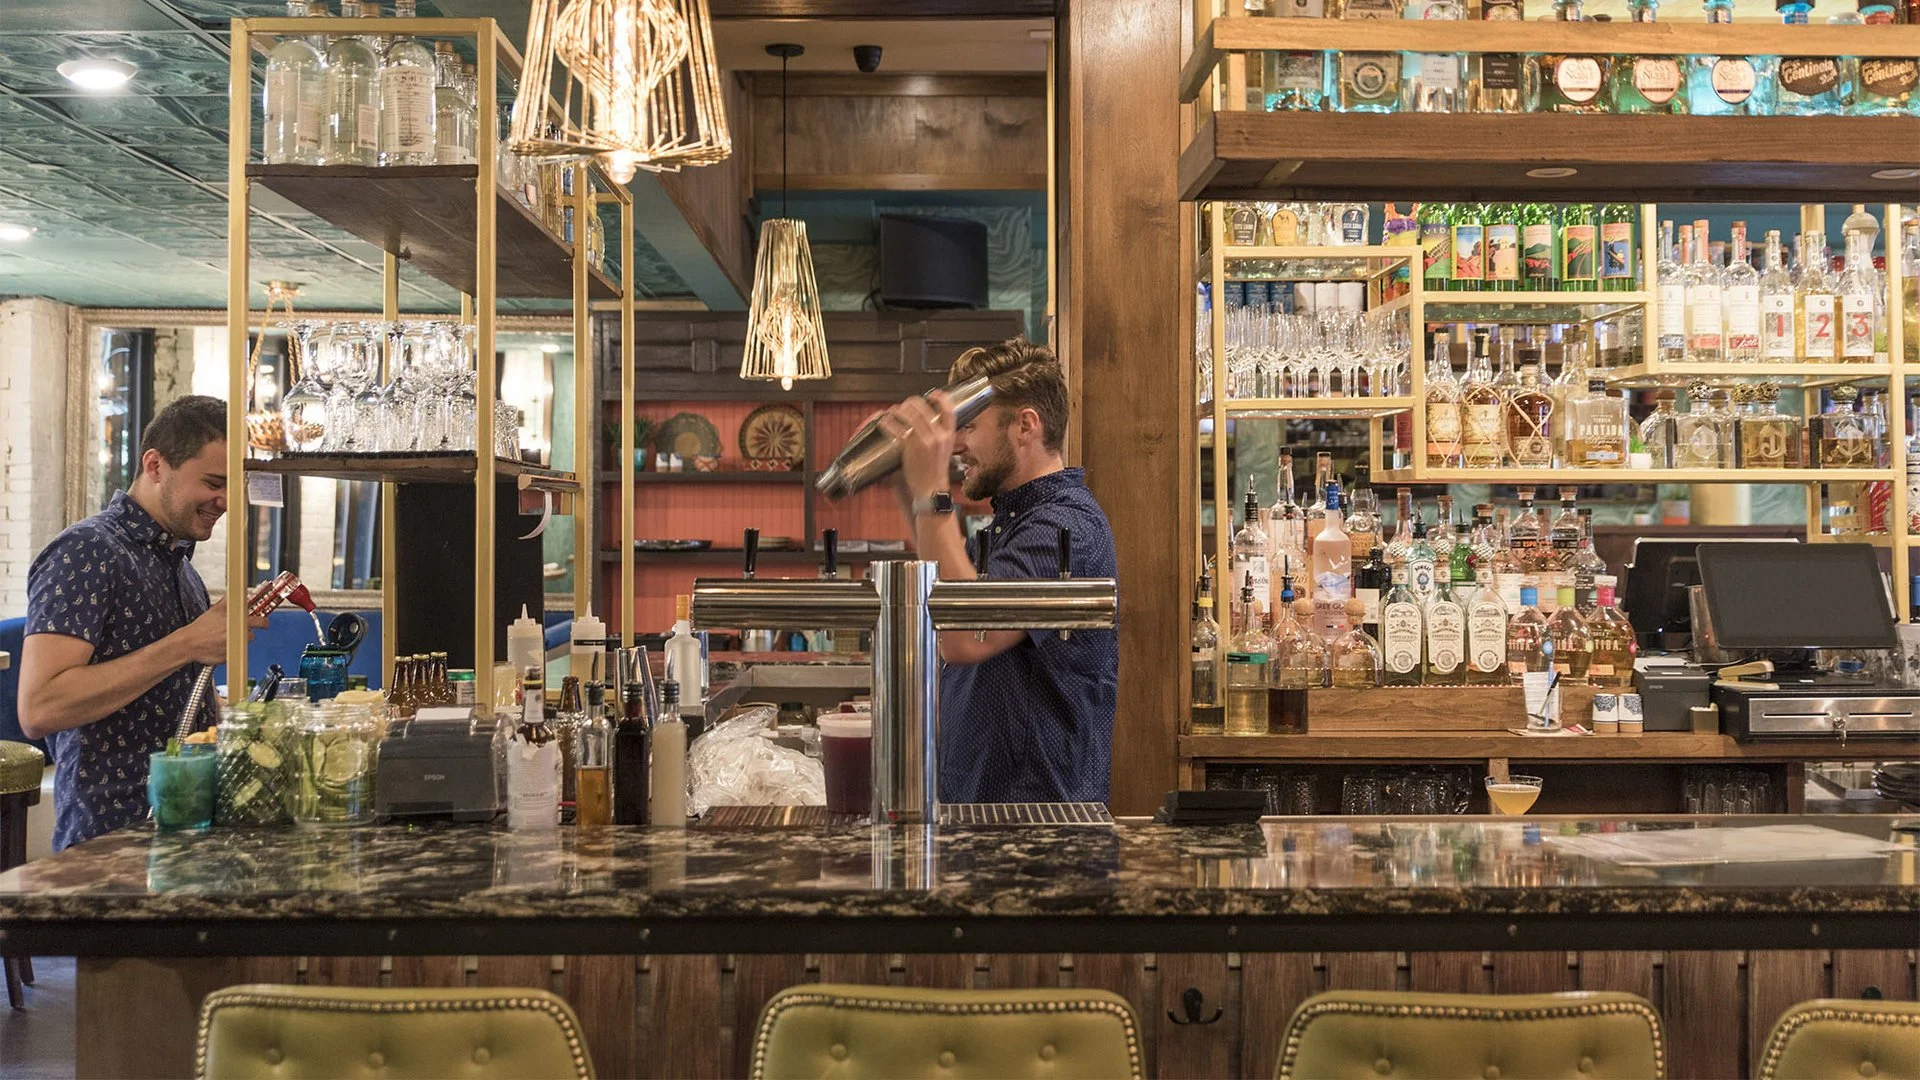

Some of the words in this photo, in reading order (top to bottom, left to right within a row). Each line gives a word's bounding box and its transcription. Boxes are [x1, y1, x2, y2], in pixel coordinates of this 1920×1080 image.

[1784, 60, 1834, 83] Centinela
[1243, 211, 1249, 222] 7
[1351, 210, 1358, 221] 7
[1777, 314, 1784, 338] 1
[1815, 314, 1830, 338] 2
[1851, 313, 1870, 337] 3
[1580, 424, 1624, 436] PARTIDA
